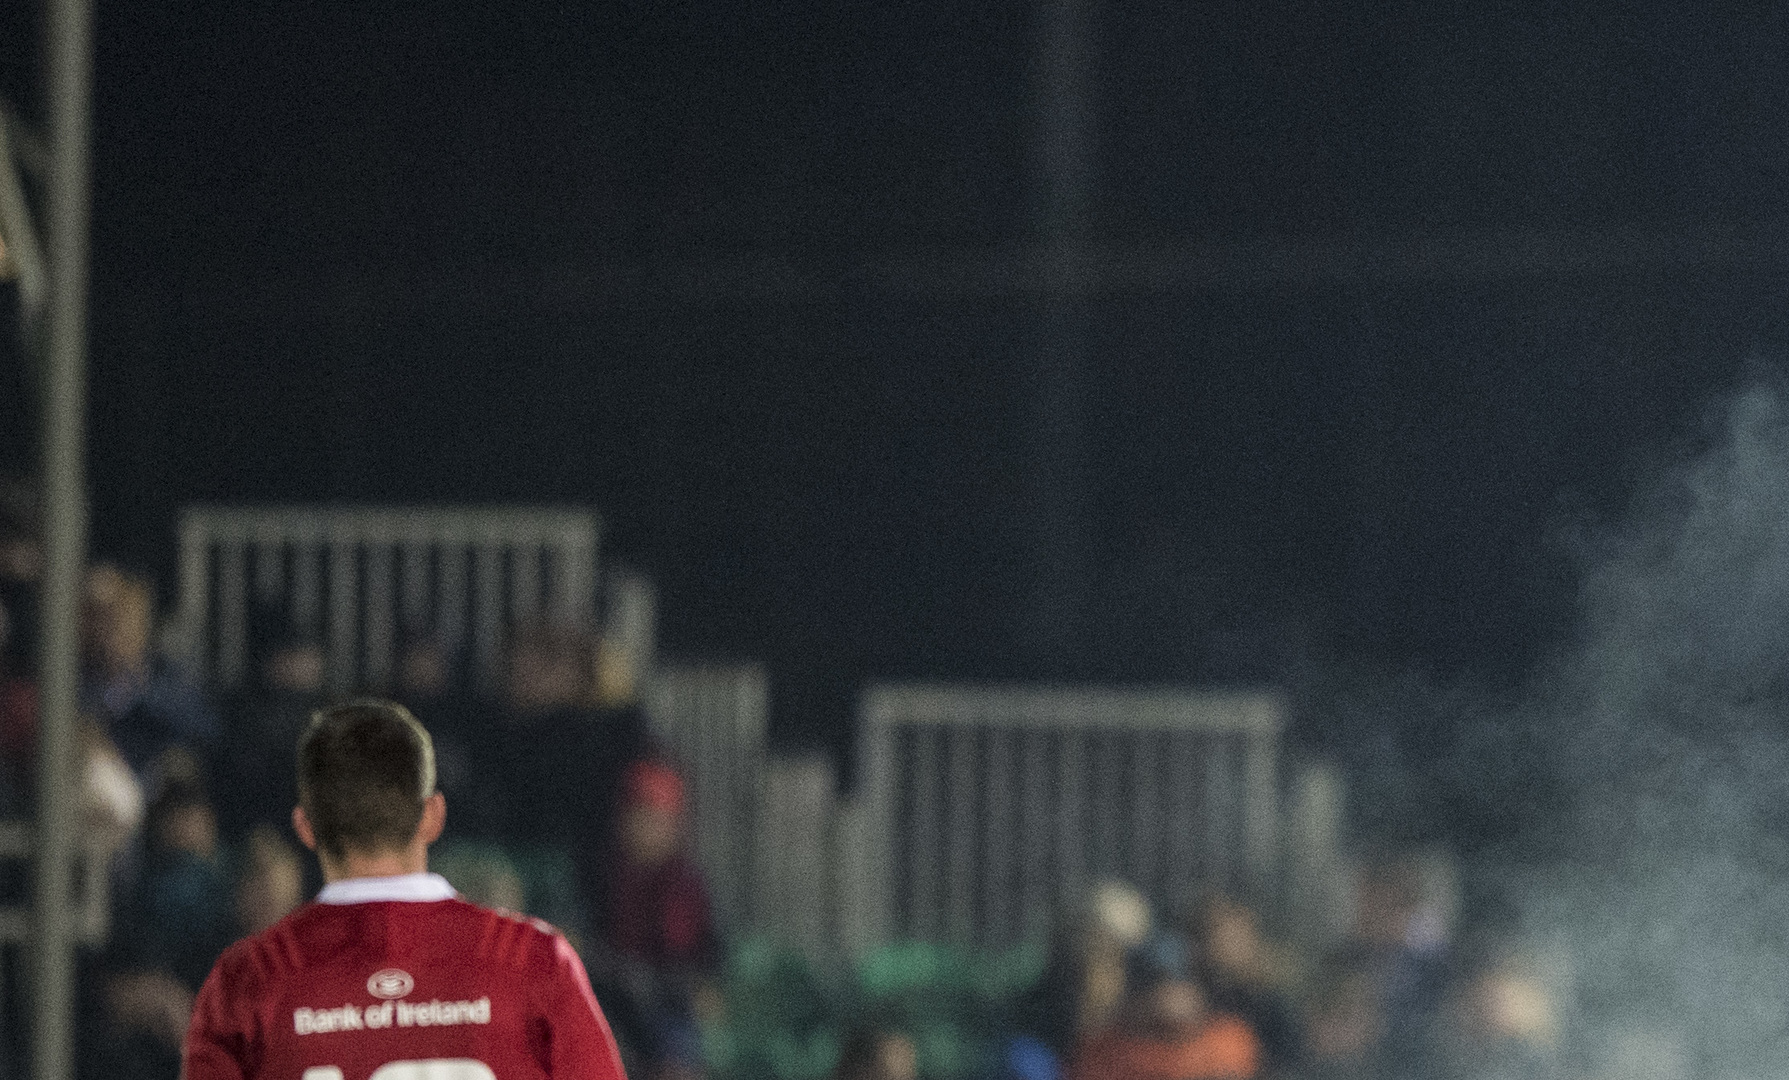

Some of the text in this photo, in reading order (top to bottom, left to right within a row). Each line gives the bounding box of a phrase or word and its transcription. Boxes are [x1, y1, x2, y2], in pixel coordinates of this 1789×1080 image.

[293, 996, 491, 1035] Bank of Ireland
